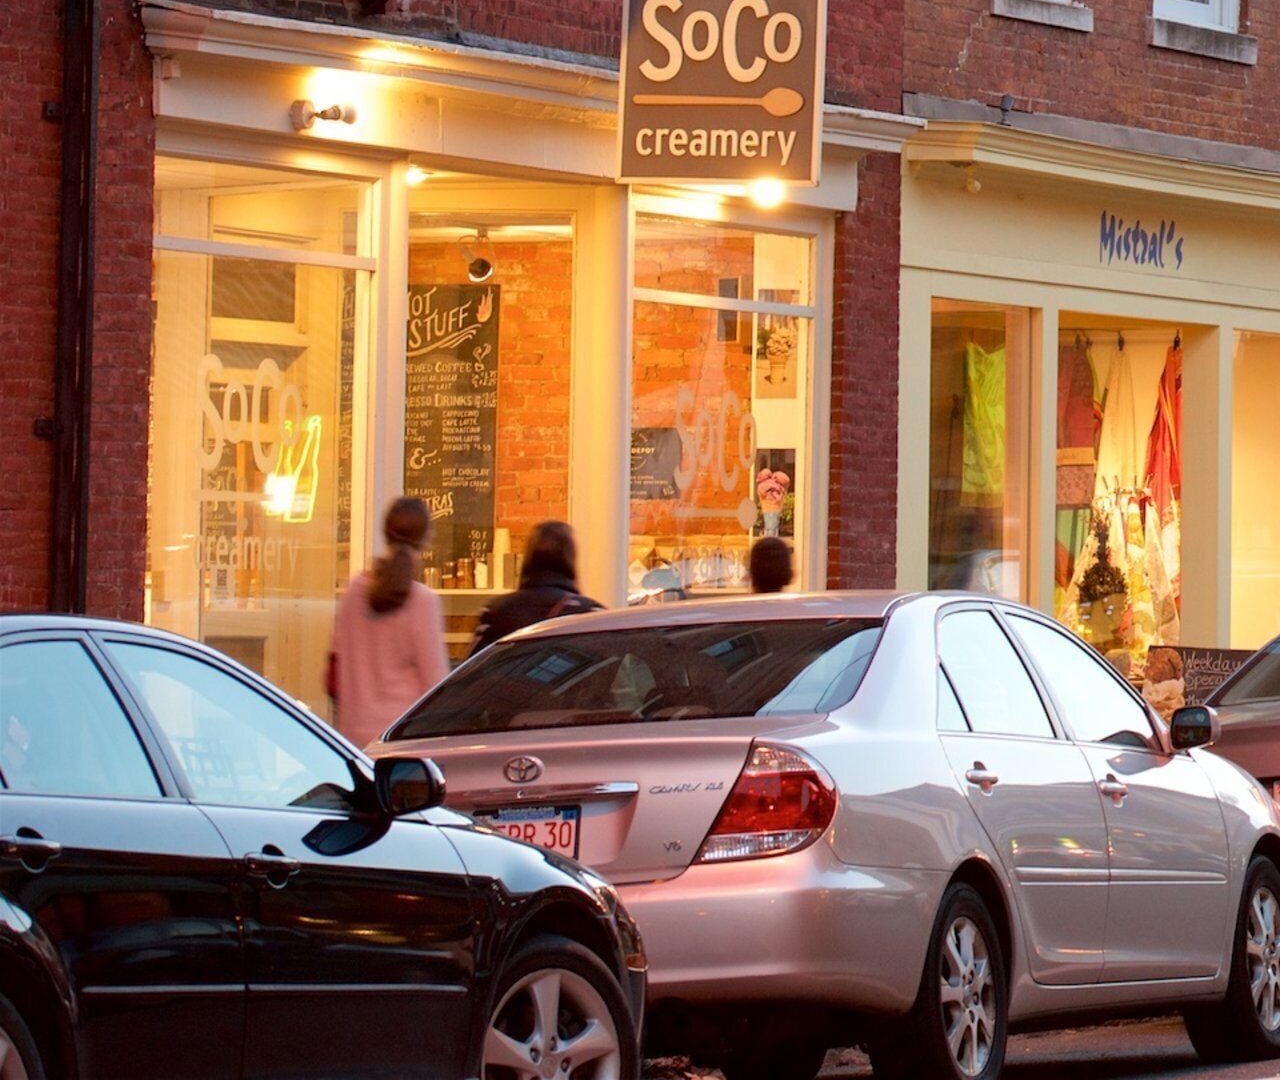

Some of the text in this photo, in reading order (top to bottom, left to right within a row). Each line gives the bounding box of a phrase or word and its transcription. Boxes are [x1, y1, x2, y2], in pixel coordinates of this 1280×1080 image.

[635, 127, 797, 167] creamery
[1099, 209, 1185, 270] Mistral's
[407, 286, 437, 320] OT
[408, 300, 472, 348] STUFF
[406, 363, 433, 373] EWED
[406, 396, 431, 408] ESSO
[425, 491, 454, 511] TRAS
[497, 821, 572, 848] PR 30
